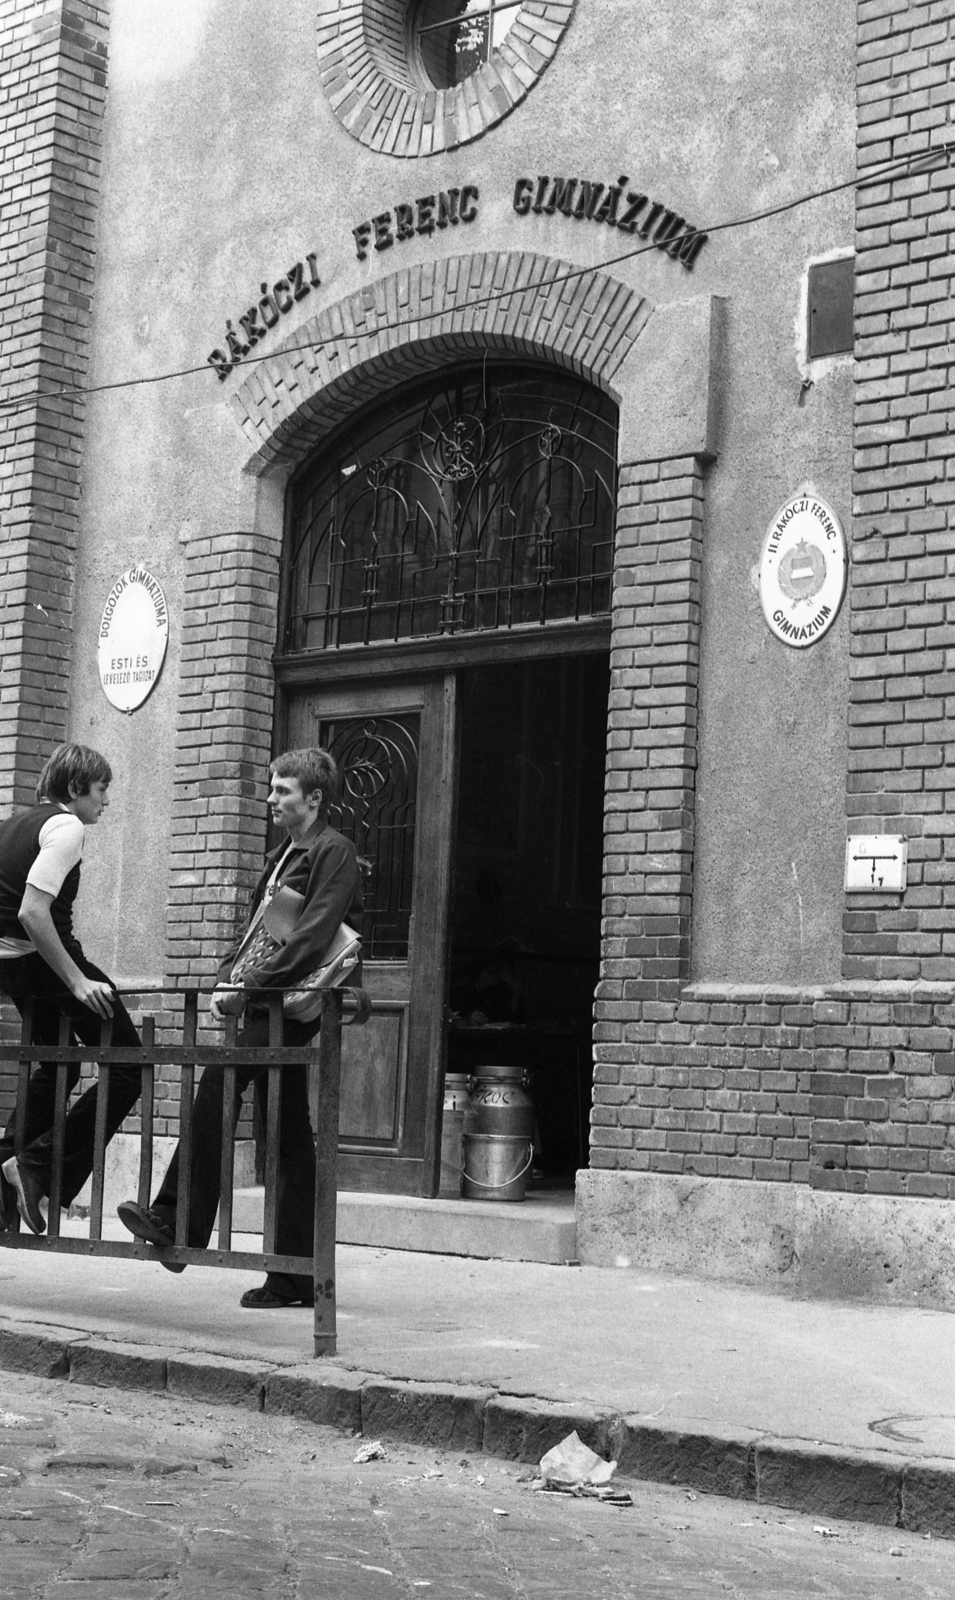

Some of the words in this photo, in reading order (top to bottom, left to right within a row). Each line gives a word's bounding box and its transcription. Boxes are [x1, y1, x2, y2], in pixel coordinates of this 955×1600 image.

[206, 252, 321, 382] RÁKÓCZI
[352, 184, 480, 261] FERENC
[512, 174, 709, 272] GIMNÁZIUM
[810, 502, 837, 541] FERENC
[110, 657, 133, 670] ESTI
[136, 654, 148, 668] ÉS
